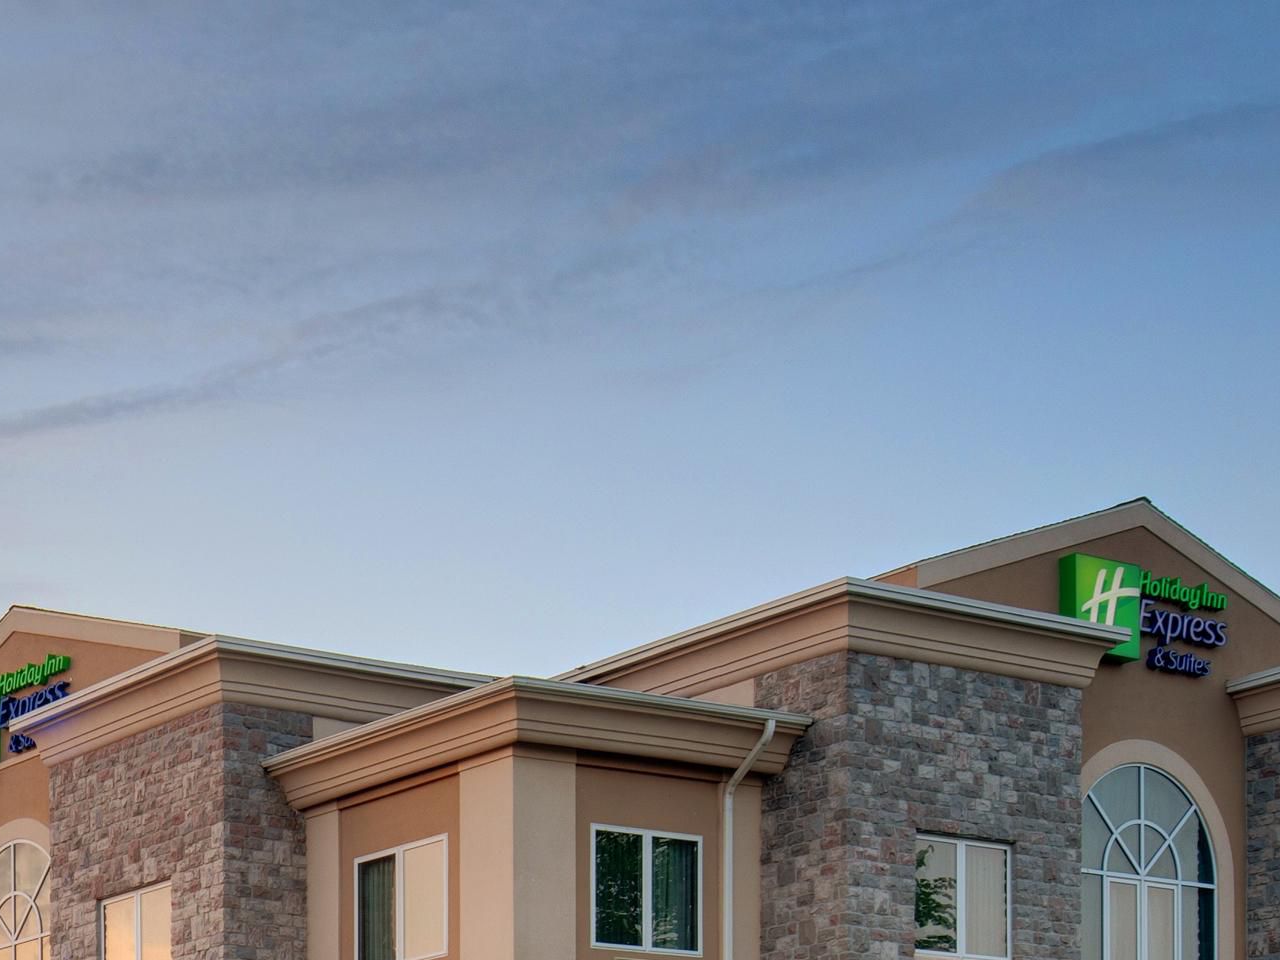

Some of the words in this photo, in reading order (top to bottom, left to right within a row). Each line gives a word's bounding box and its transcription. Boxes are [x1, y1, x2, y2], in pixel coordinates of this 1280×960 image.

[1140, 570, 1201, 609] Holiday
[1202, 583, 1228, 609] Inn
[1140, 599, 1227, 646] Express
[44, 655, 64, 676] Inn
[1155, 646, 1165, 667] &
[1167, 650, 1211, 675] Suites
